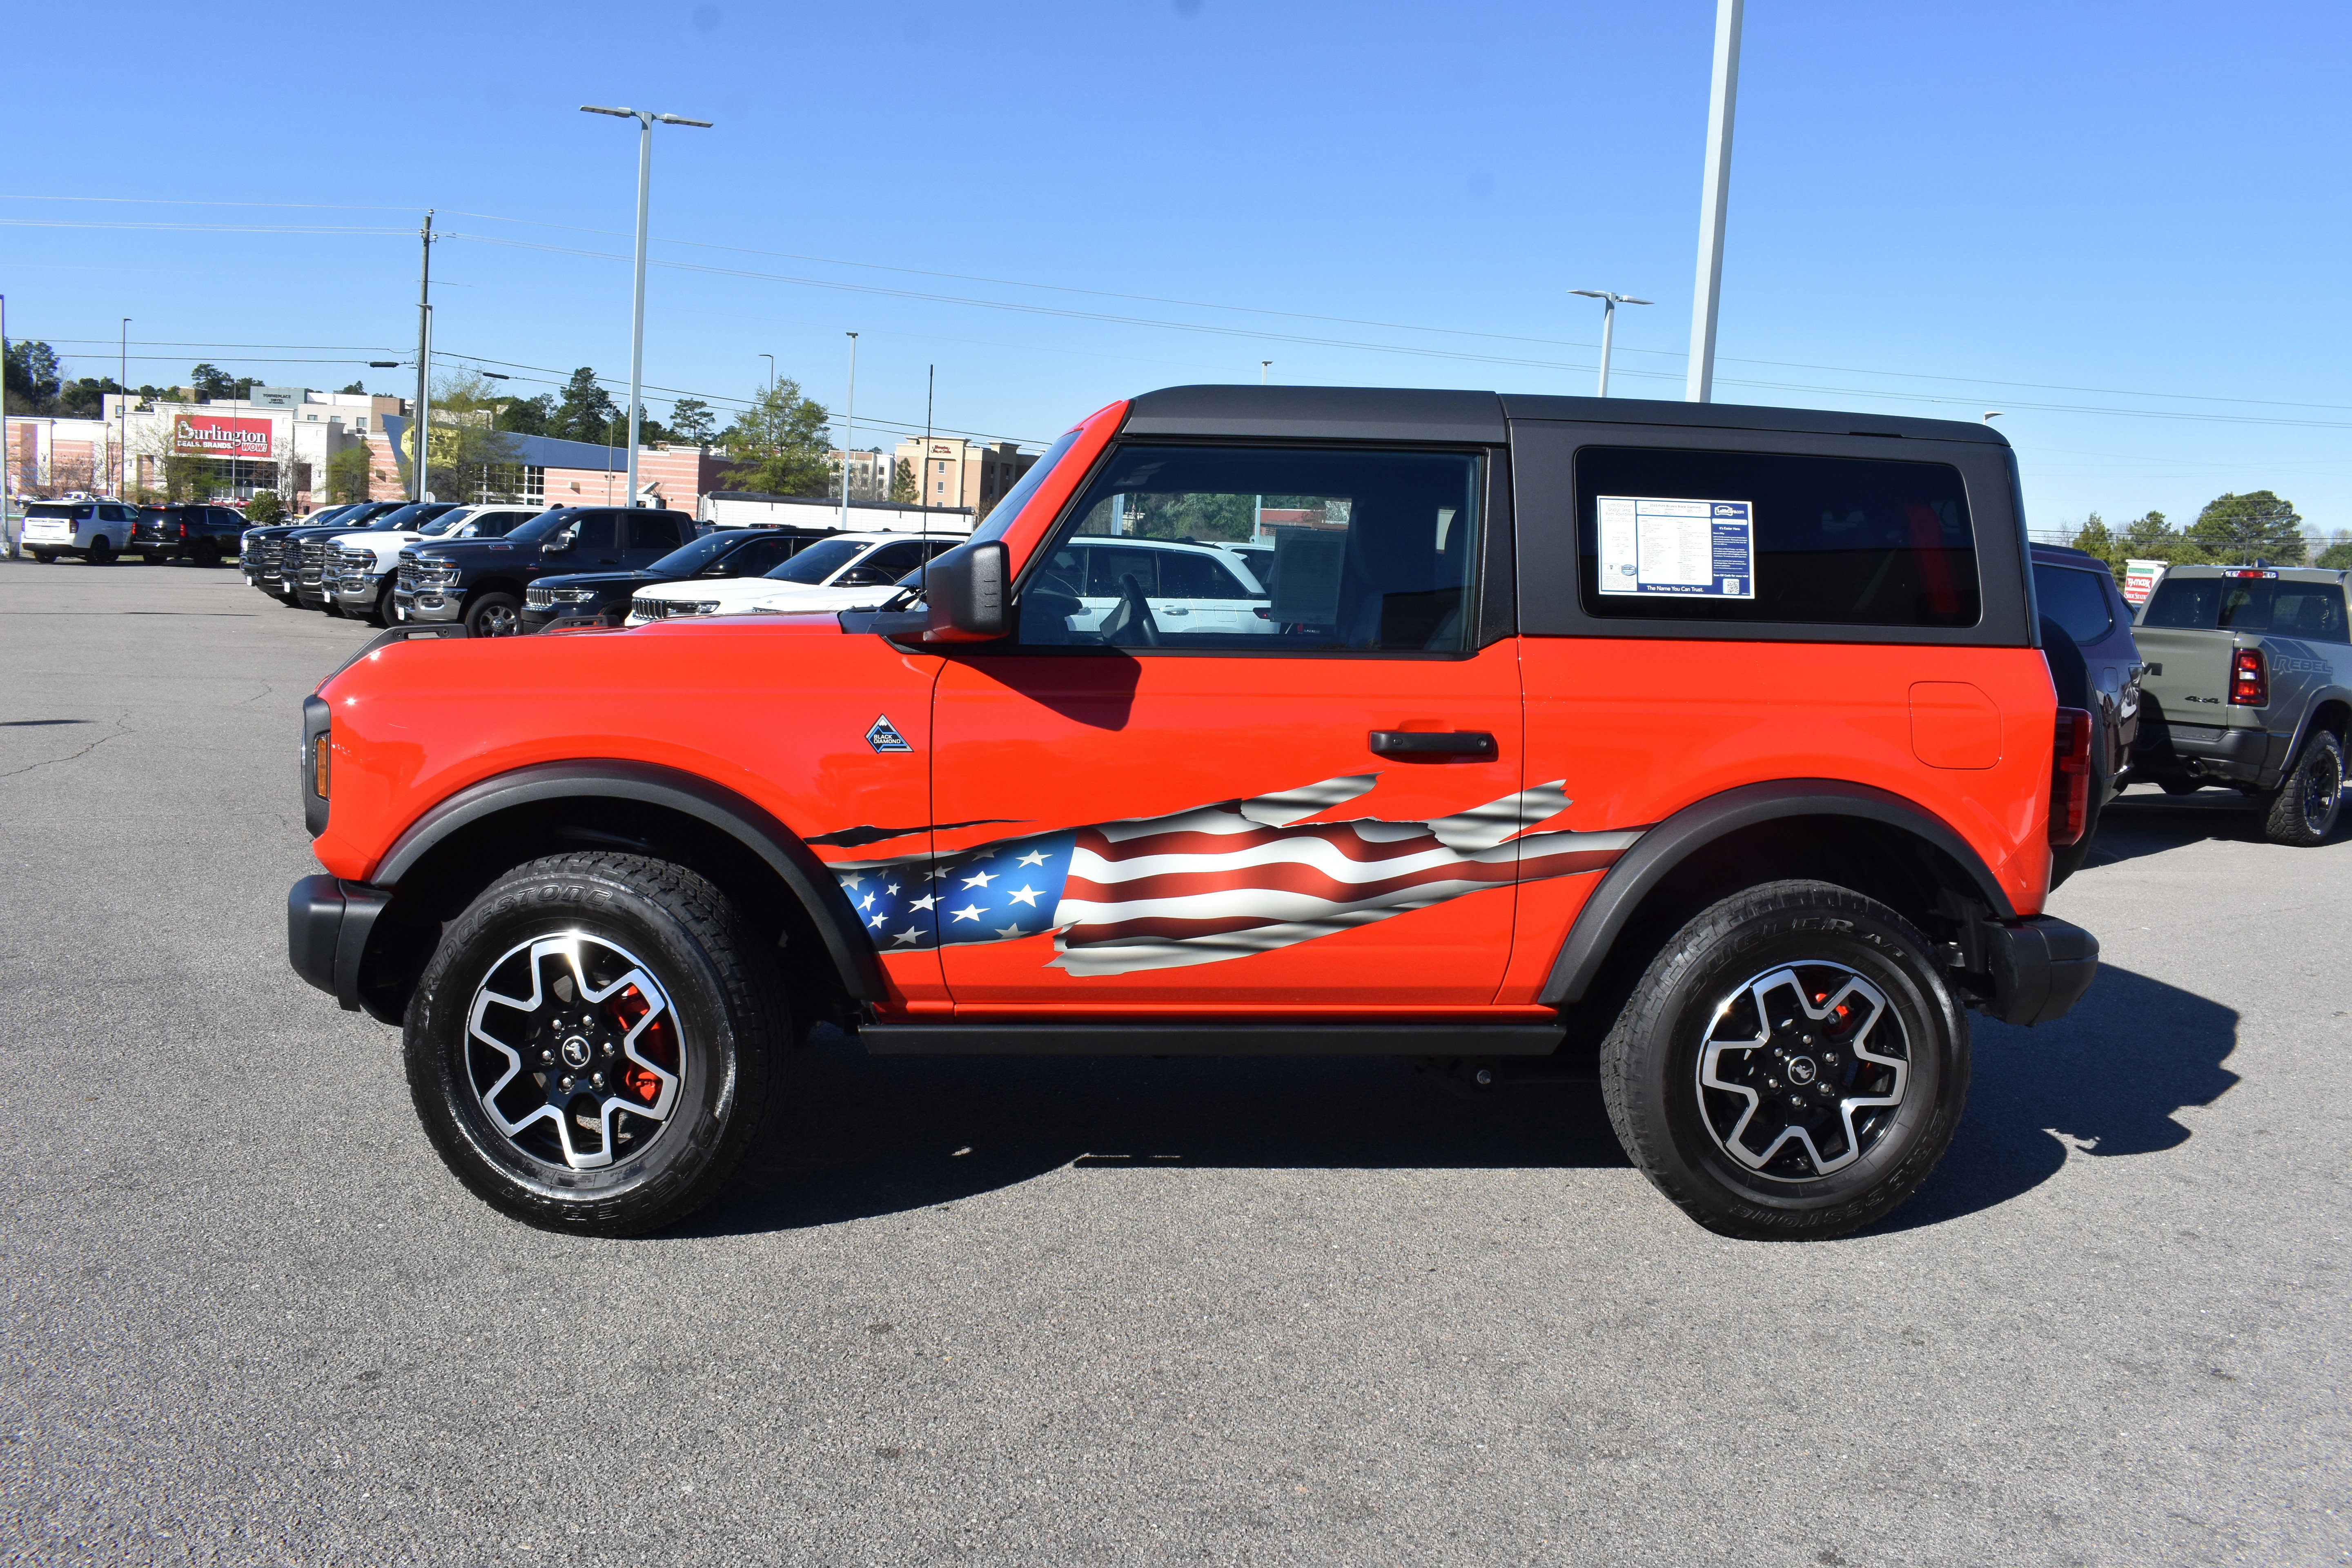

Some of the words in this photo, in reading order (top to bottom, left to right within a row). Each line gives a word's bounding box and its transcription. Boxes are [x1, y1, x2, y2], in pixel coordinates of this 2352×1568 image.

[178, 421, 267, 446] Burlington
[242, 442, 268, 452] WOW!
[2272, 655, 2333, 674] REBEL
